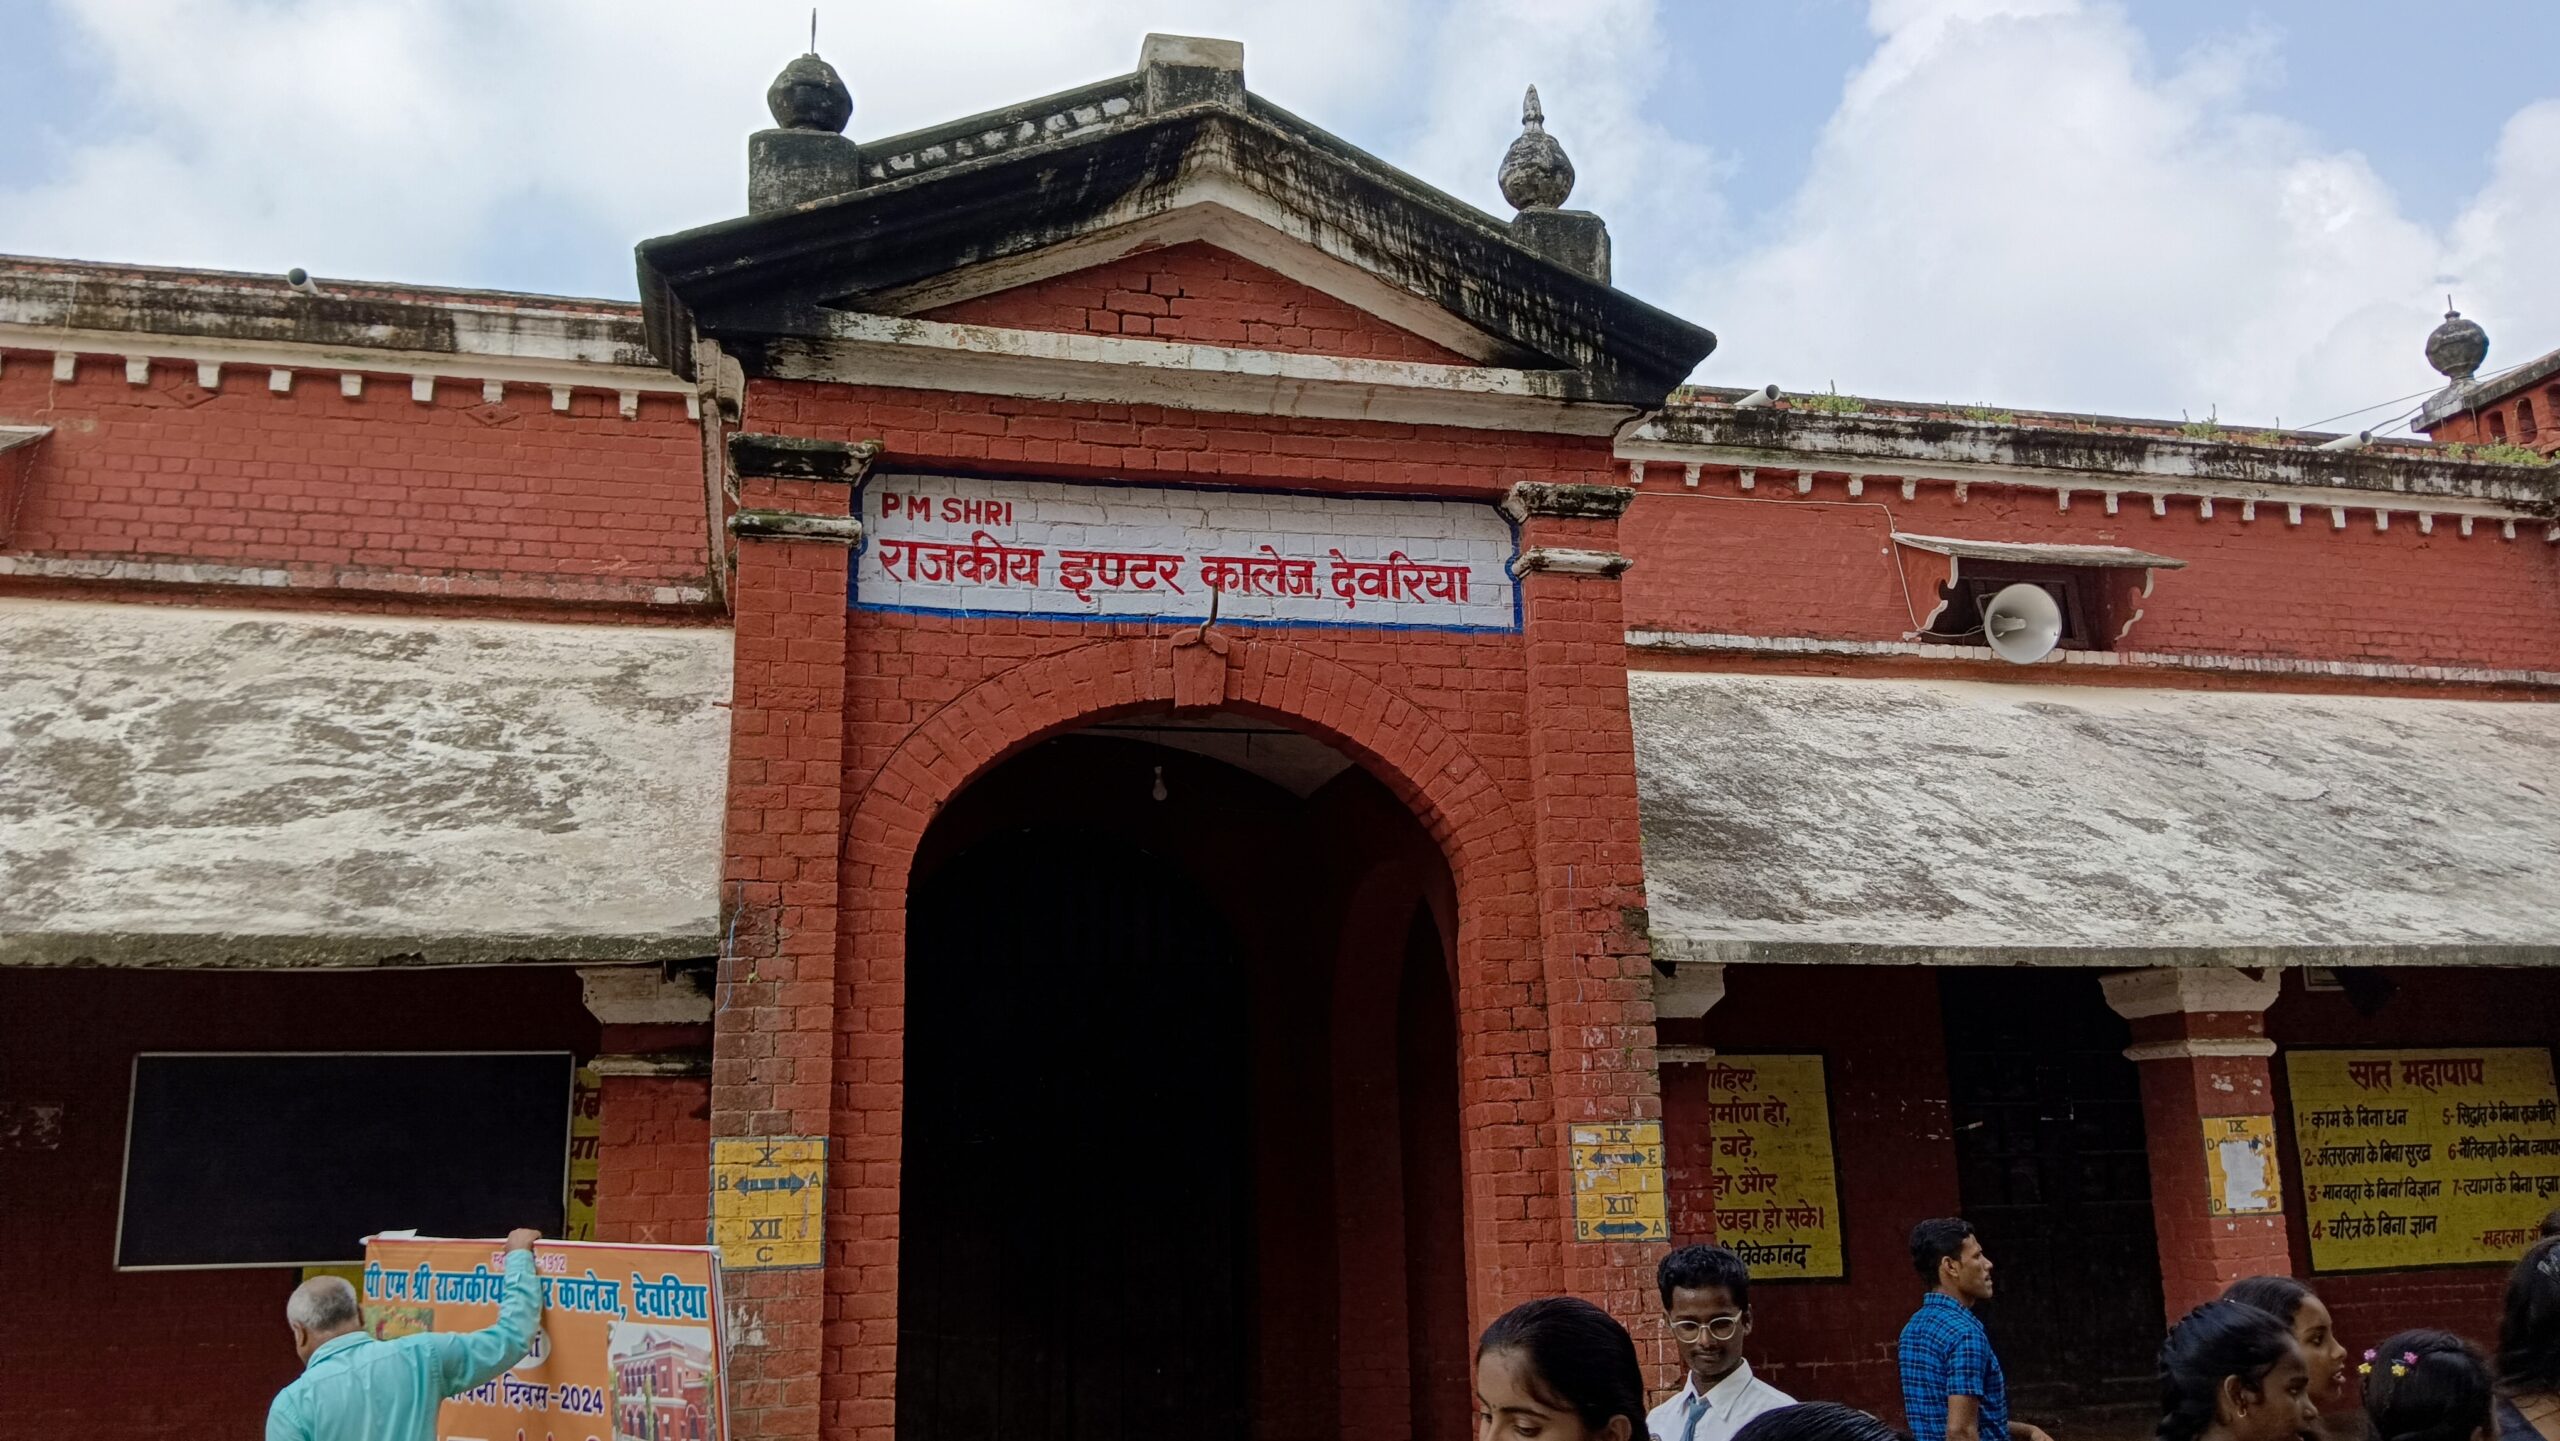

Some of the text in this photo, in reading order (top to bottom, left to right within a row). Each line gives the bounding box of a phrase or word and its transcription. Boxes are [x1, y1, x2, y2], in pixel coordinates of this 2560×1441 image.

[941, 497, 1012, 526] SHRI
[879, 530, 1046, 587] राजकीय
[1058, 550, 1186, 602] इण्टर
[1329, 548, 1471, 609] देवरिया
[2348, 1058, 2485, 1094] सात महापाप
[1763, 1094, 1791, 1128] हो,
[2312, 1110, 2341, 1129] काम
[2343, 1104, 2355, 1127] के
[2356, 1104, 2385, 1128] बिना
[2386, 1108, 2409, 1126] धन
[2488, 1100, 2499, 1122] के
[2499, 1100, 2521, 1123] बिना
[1605, 1128, 1633, 1143] IX
[2497, 1133, 2508, 1158] के
[2508, 1132, 2531, 1157] बिना
[752, 1146, 783, 1168] X
[1648, 1148, 1657, 1165] E
[2367, 1138, 2379, 1164] के
[2379, 1138, 2404, 1163] बिना
[2405, 1143, 2433, 1168] सुख
[717, 1171, 821, 1191] B A
[2322, 1183, 2362, 1205] मानवता
[2363, 1177, 2375, 1199] के
[2376, 1177, 2403, 1199] बिना
[2404, 1175, 2443, 1202] विज्ञान
[2463, 1177, 2494, 1197] त्याग
[2494, 1171, 2507, 1194] के
[2508, 1169, 2533, 1194] बिना
[2534, 1175, 2560, 1200] पूजा
[1604, 1196, 1635, 1215] XII
[1716, 1207, 1761, 1235] खड़ा
[1762, 1199, 1784, 1234] हो
[747, 1217, 784, 1241] XII
[1580, 1219, 1664, 1237] B A
[2328, 1211, 2362, 1240] चरित्र
[2362, 1210, 2376, 1237] के
[2377, 1210, 2408, 1237] बिना
[2409, 1215, 2438, 1239] ज्ञान
[2482, 1229, 2526, 1250] महात्मा
[756, 1246, 774, 1263] C
[364, 1262, 382, 1298] पी
[384, 1270, 409, 1300] एम
[412, 1263, 432, 1301] श्री
[556, 1270, 627, 1321] कालेज,
[632, 1272, 708, 1319] देवरिया
